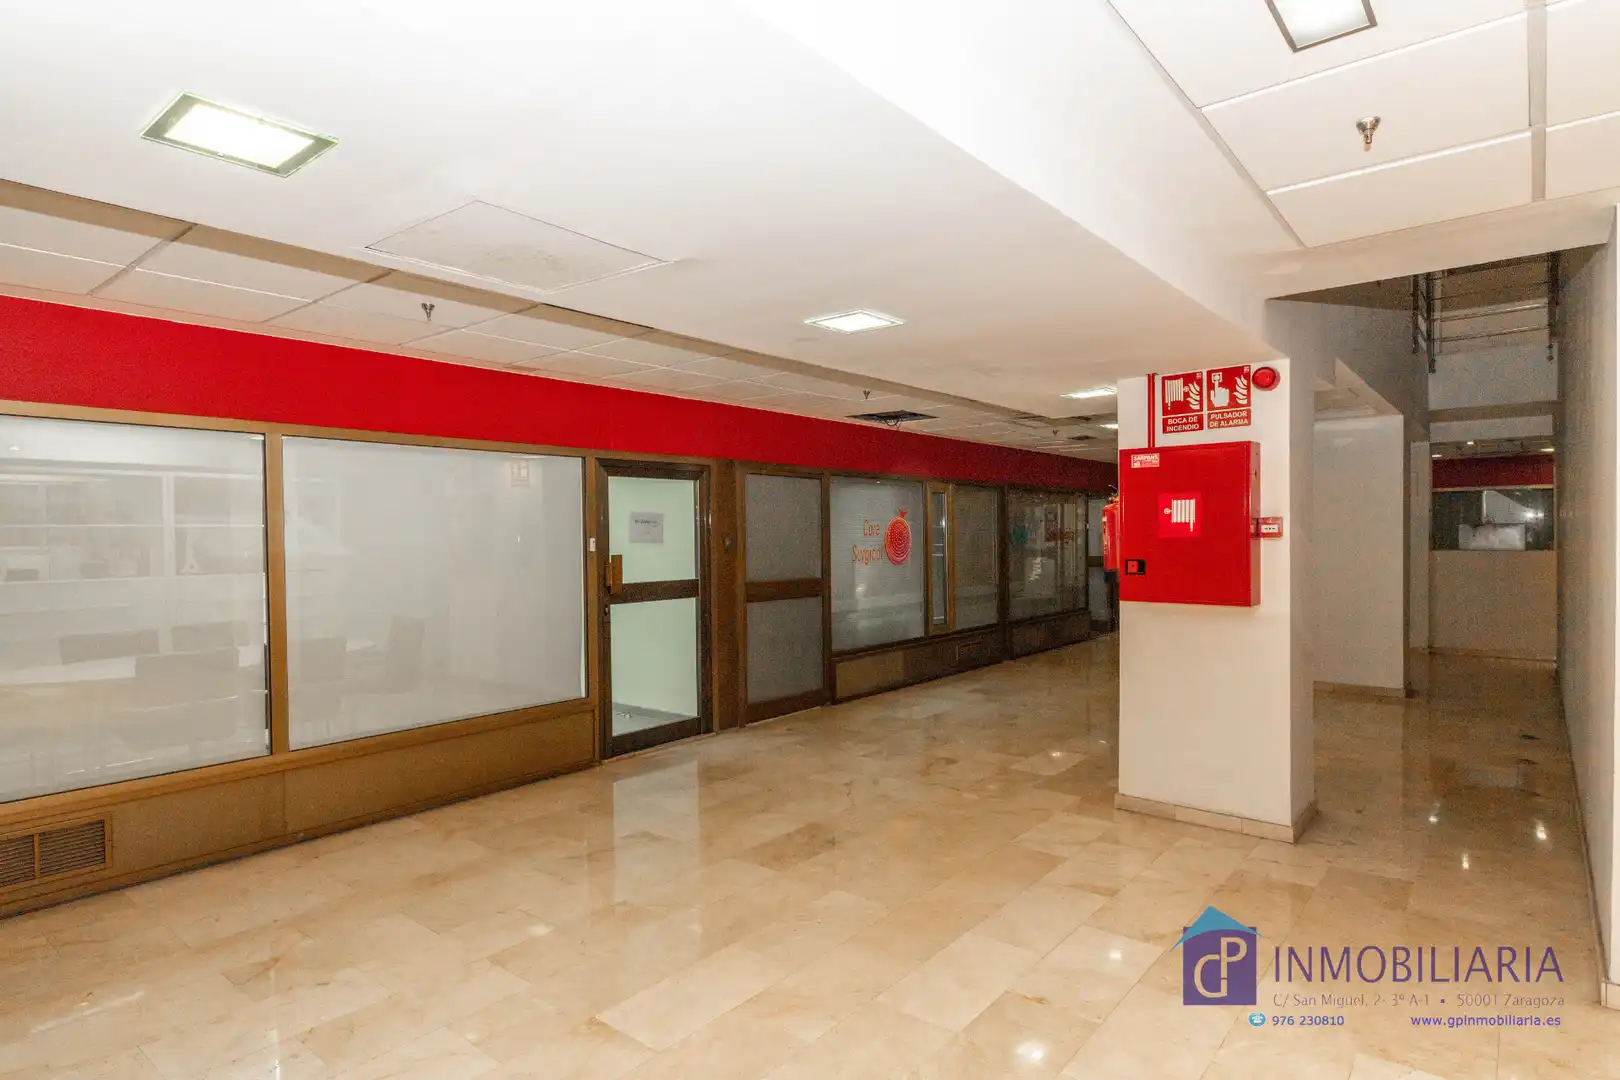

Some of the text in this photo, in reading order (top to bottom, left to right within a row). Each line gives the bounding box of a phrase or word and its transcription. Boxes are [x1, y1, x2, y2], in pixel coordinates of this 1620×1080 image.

[1210, 411, 1247, 419] PULSADOR
[1168, 417, 1187, 425] BOCA
[1220, 418, 1249, 427] ALARMA
[1166, 423, 1199, 432] INCENDIO
